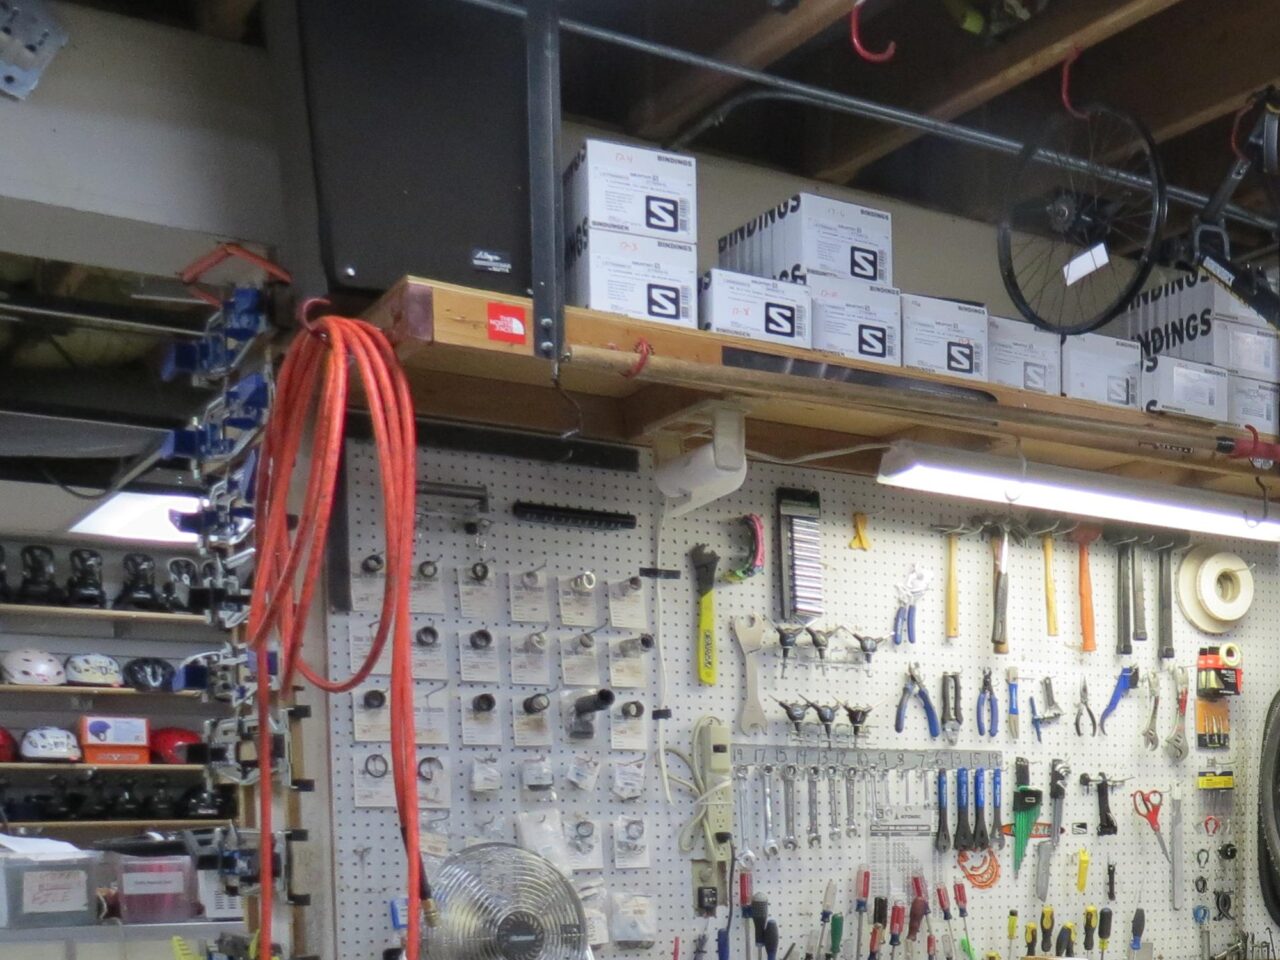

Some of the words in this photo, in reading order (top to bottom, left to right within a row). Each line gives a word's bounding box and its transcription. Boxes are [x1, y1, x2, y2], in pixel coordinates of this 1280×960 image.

[657, 155, 692, 167] BINDINGS
[657, 241, 692, 252] BINDINGS
[1137, 308, 1212, 359] NDINGS
[733, 748, 743, 762] 19
[755, 748, 767, 763] 17
[776, 749, 788, 762] 15
[818, 749, 829, 766] 13
[857, 750, 868, 766] 10
